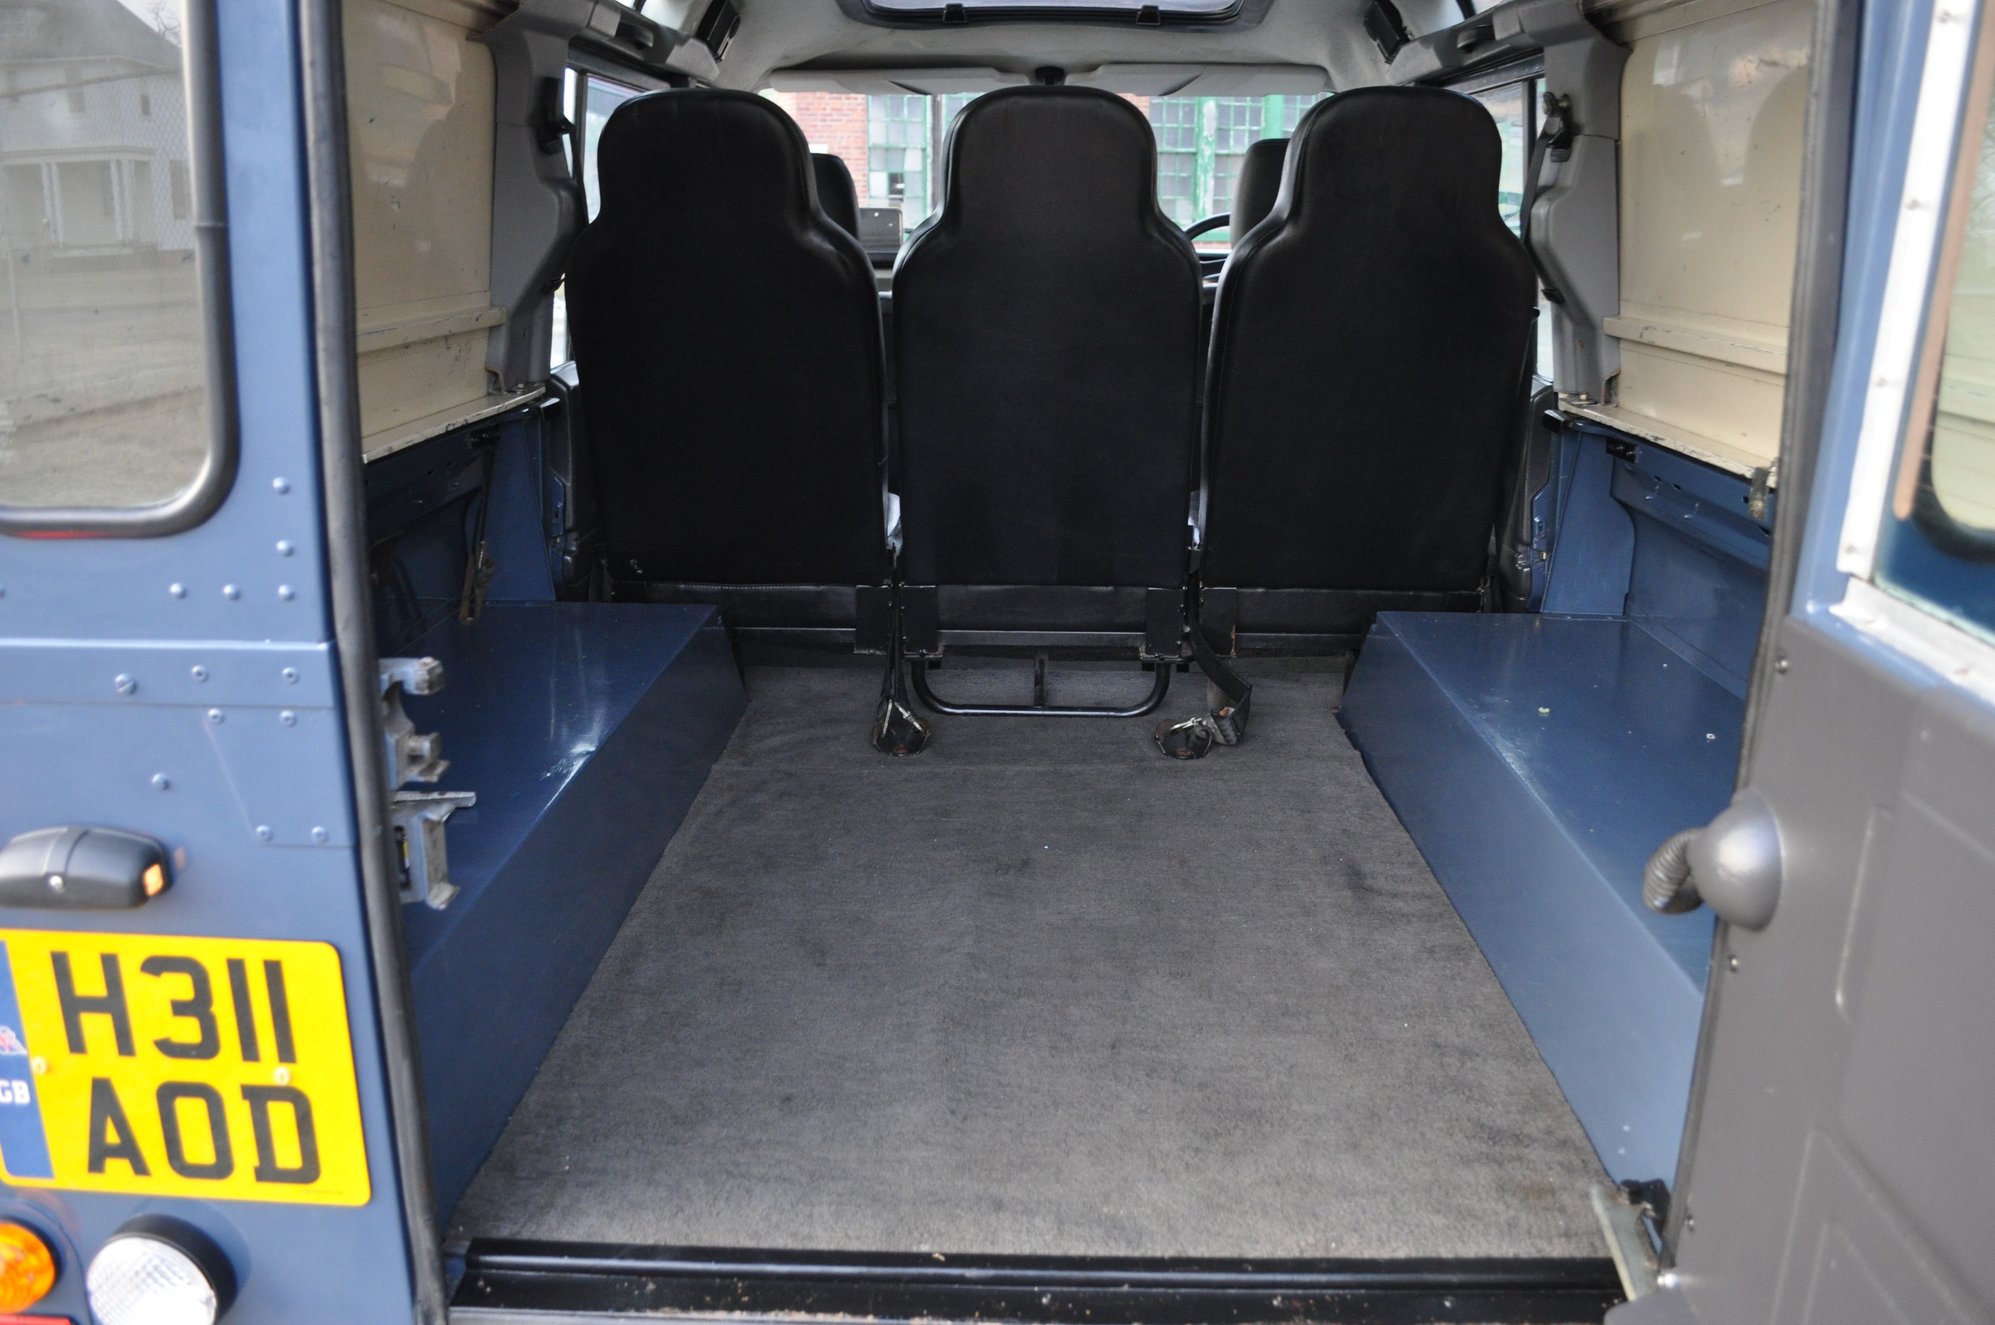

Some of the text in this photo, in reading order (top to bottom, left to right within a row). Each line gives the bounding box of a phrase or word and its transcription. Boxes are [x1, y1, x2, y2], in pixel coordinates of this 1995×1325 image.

[50, 950, 297, 1064] H311
[0, 1079, 31, 1104] GB
[87, 1077, 322, 1185] AOD
